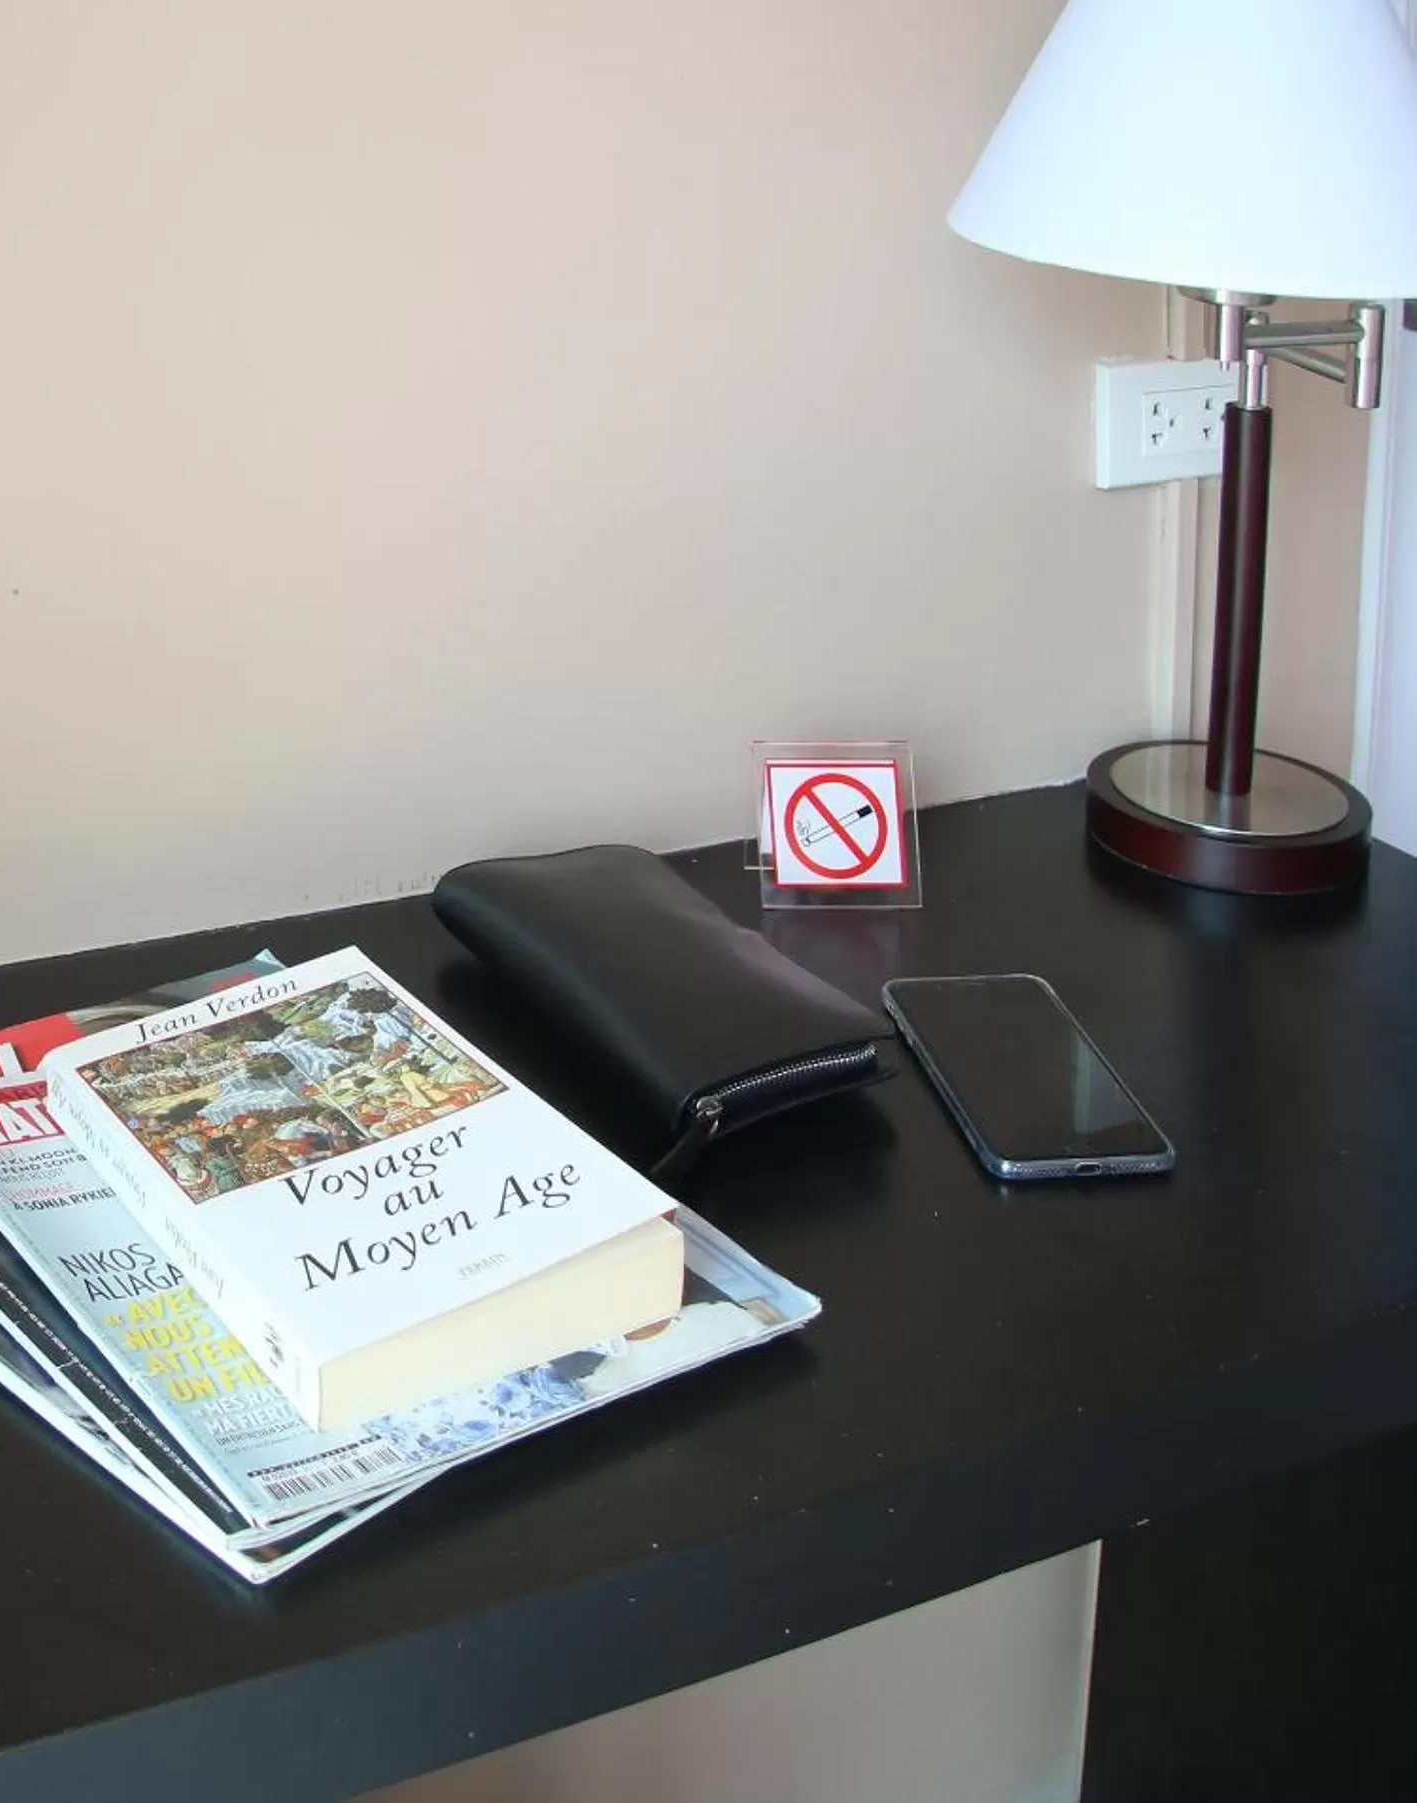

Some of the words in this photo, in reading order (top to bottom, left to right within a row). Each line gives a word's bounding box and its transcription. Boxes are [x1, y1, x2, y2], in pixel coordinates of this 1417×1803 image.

[135, 1008, 199, 1044] Jean
[206, 976, 298, 1018] Verdon
[277, 1125, 469, 1206] Voyager
[383, 1186, 444, 1216] au
[295, 1211, 477, 1292] Moyen
[494, 1161, 581, 1219] Age
[57, 1243, 156, 1278] NIKOS
[83, 1263, 185, 1303] ALIAGA
[166, 1374, 218, 1403] UN
